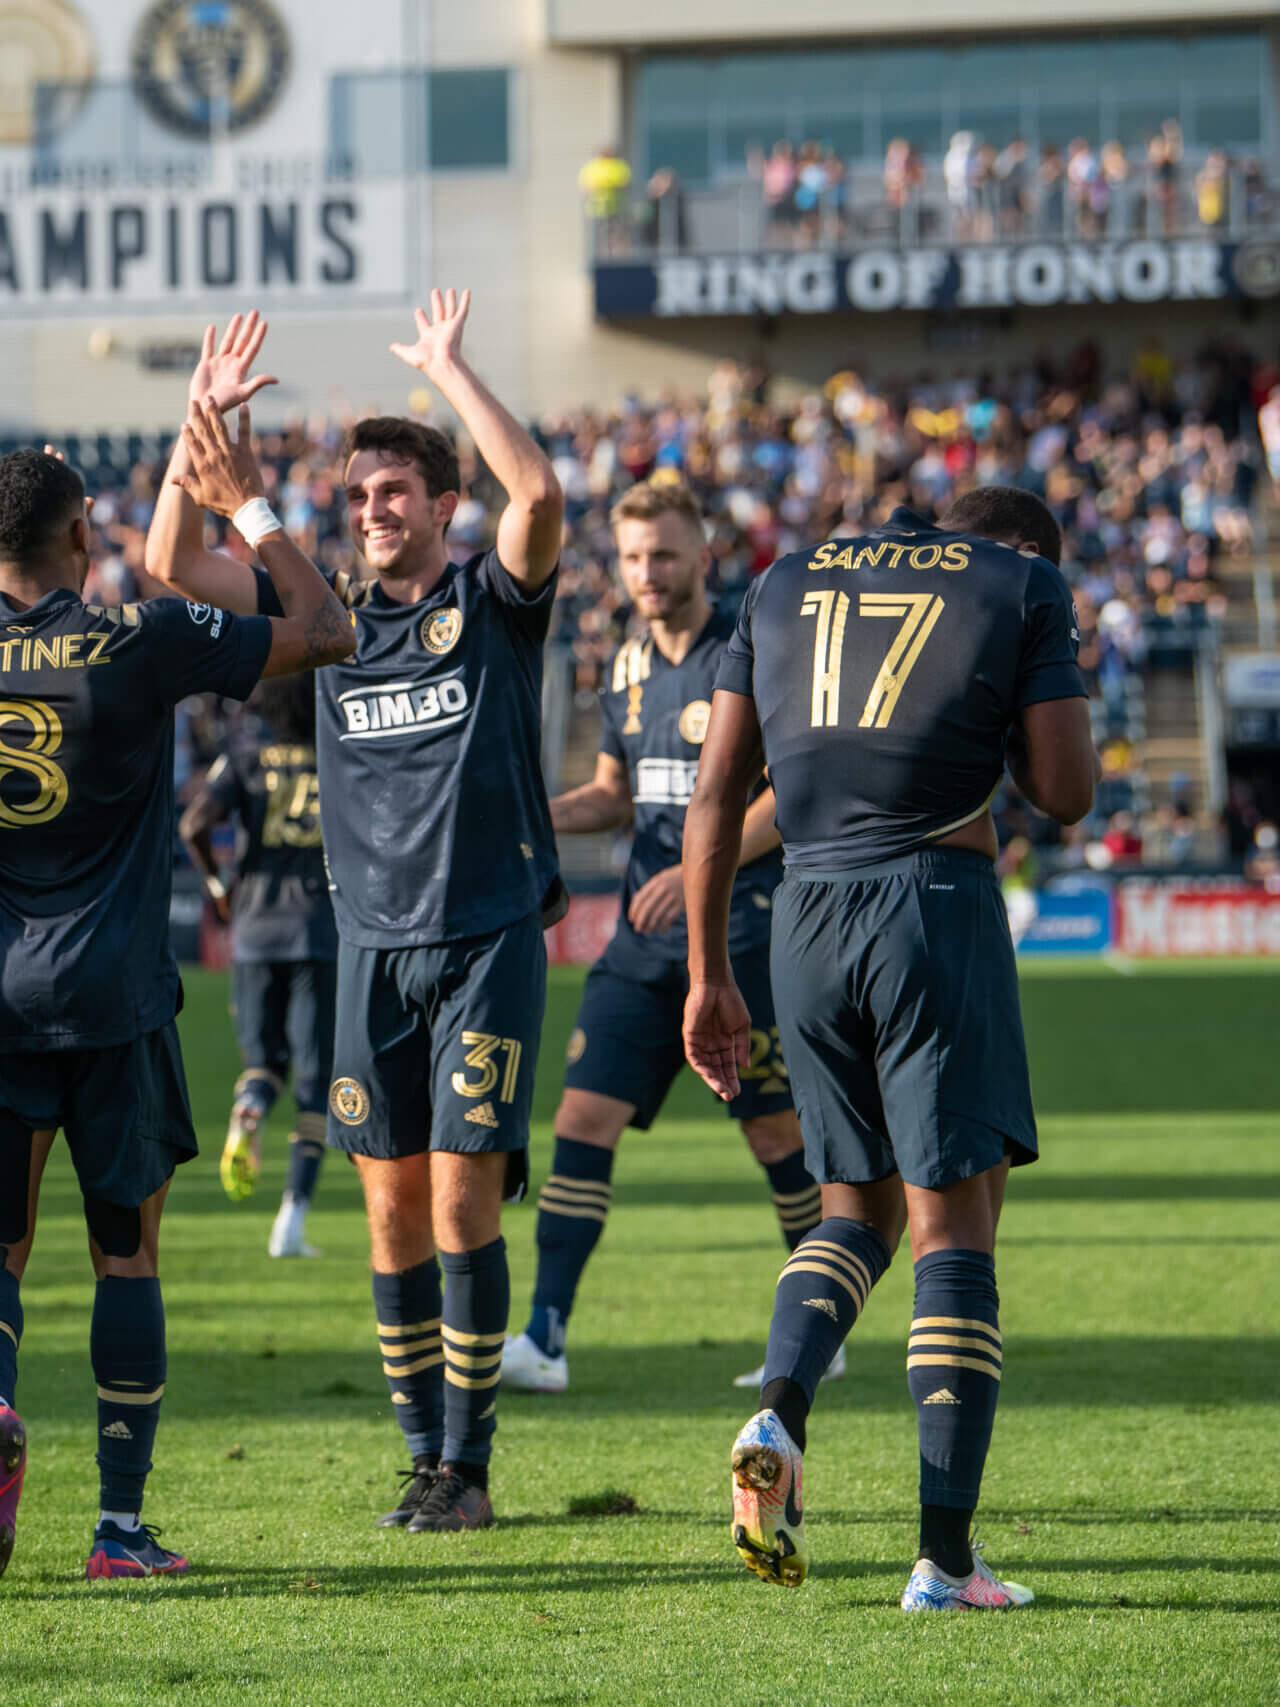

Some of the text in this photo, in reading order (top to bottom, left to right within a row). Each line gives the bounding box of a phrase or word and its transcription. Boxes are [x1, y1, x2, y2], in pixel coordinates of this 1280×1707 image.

[652, 240, 1224, 317] RING OF HONOR
[807, 542, 973, 572] SANTOS
[799, 589, 946, 729] 17
[342, 678, 469, 732] BIMBO
[451, 1030, 522, 1105] 31
